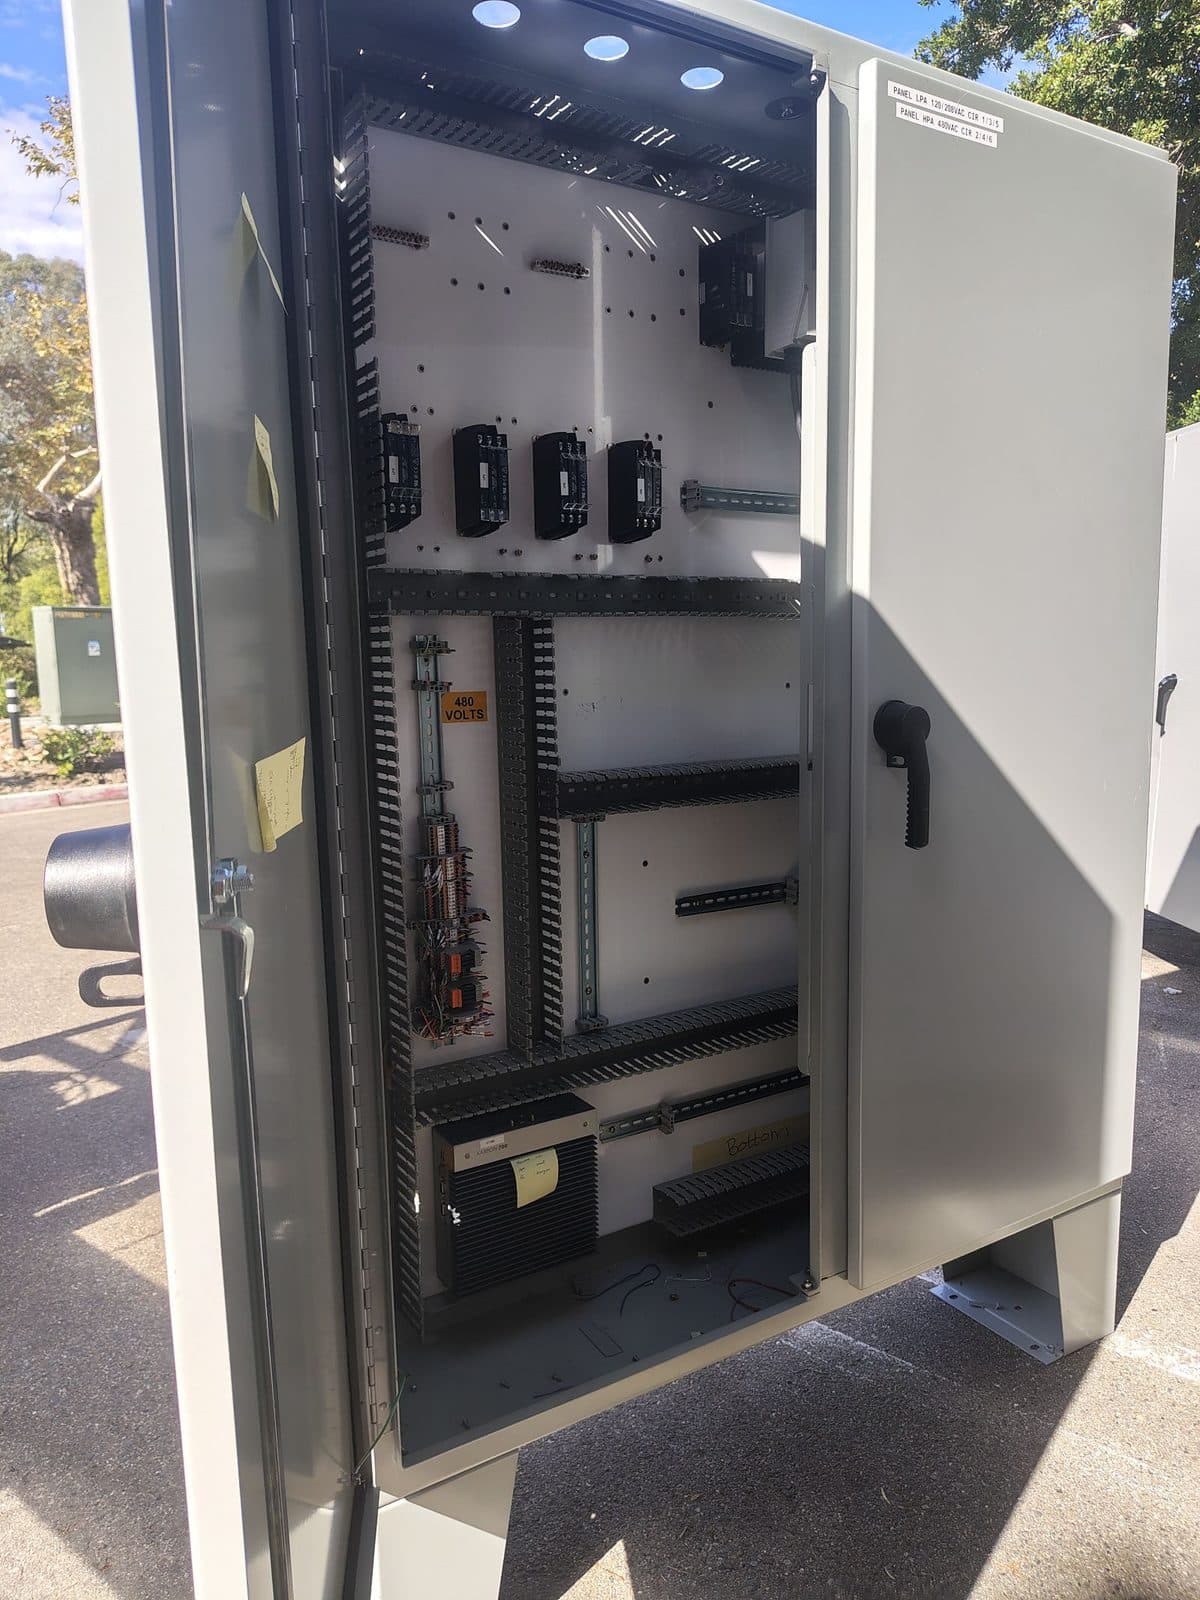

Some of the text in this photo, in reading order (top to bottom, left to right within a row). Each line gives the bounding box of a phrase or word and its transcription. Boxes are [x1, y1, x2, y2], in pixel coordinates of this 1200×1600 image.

[893, 86, 1000, 128] PANEL LPA 120/208VAC CIR 1/3/5
[900, 107, 993, 143] PANEL HPA 480VAC CIR 2/4/6
[455, 696, 474, 707] 480
[445, 709, 484, 720] VOLTS
